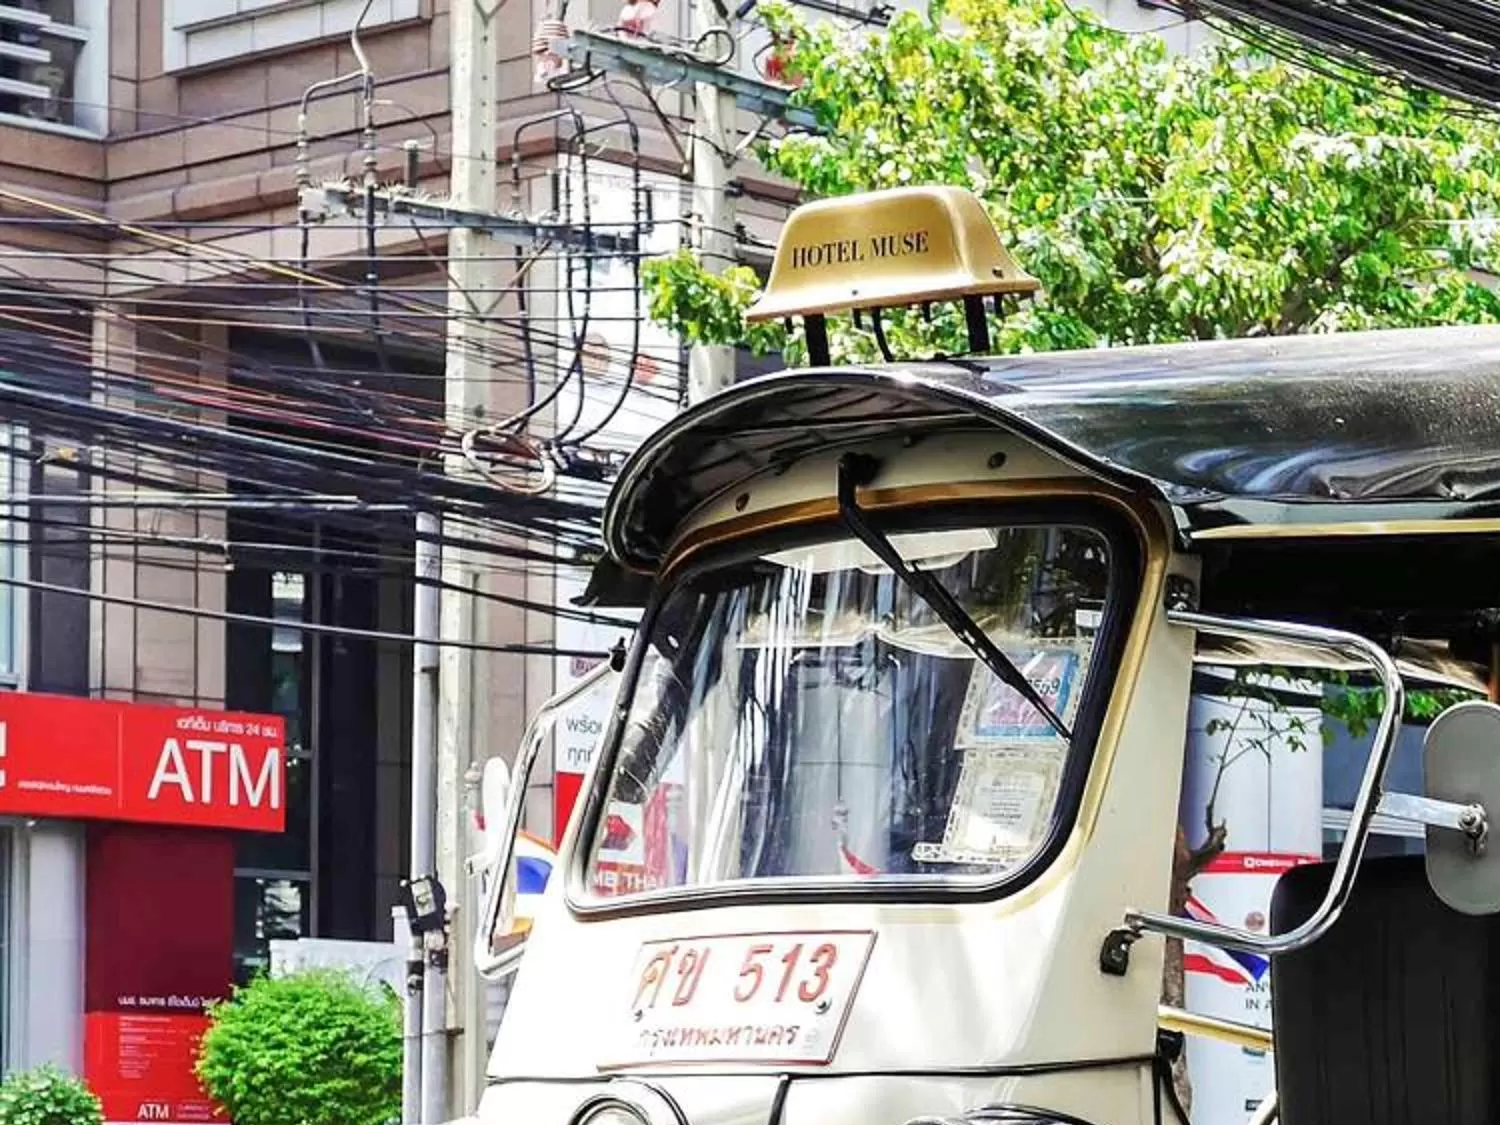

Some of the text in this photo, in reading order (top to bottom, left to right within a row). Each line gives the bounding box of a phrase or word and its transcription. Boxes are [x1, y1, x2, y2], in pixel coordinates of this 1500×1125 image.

[792, 231, 929, 268] HOTEL MUSE
[147, 737, 281, 809] ATM
[733, 943, 838, 1003] 513
[137, 1103, 170, 1119] ATM
